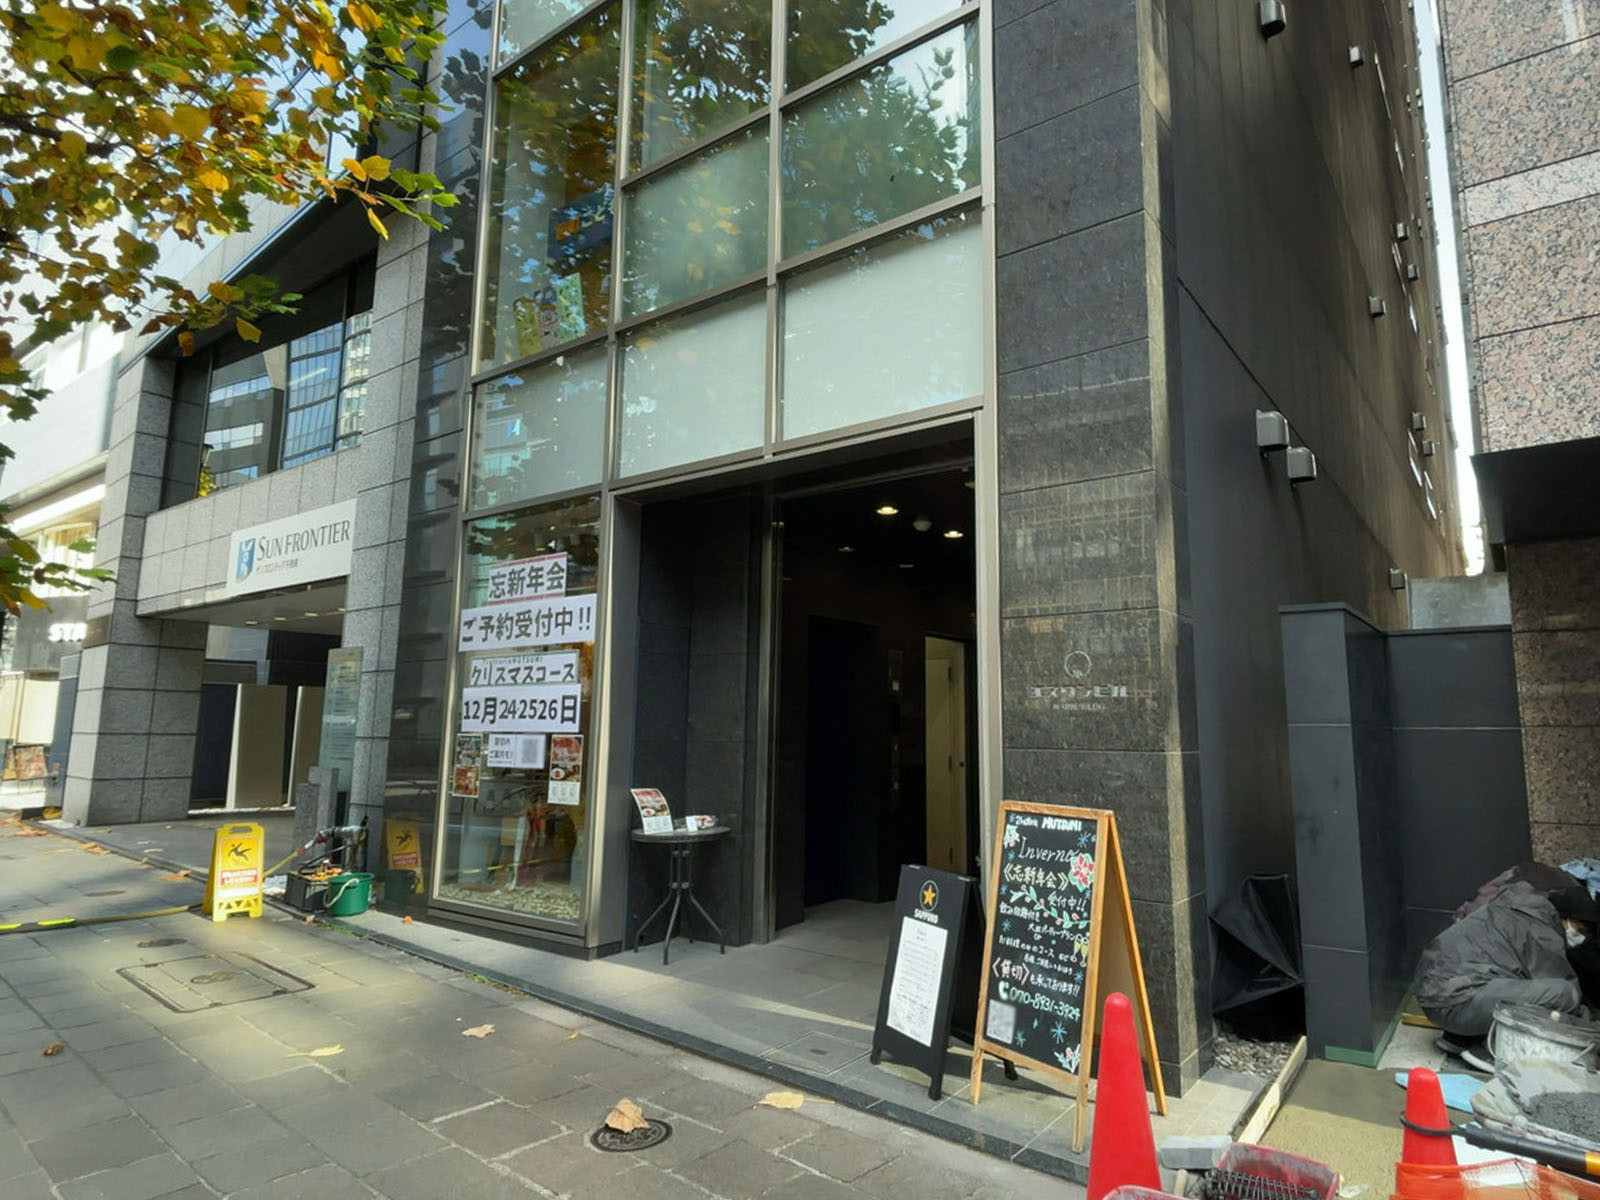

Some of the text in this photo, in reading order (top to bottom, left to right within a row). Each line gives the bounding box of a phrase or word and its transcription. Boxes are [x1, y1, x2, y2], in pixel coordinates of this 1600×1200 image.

[257, 519, 351, 562] SUN FRONTIER
[489, 561, 566, 599] 忘新年会
[472, 663, 576, 687] クリスマスコース
